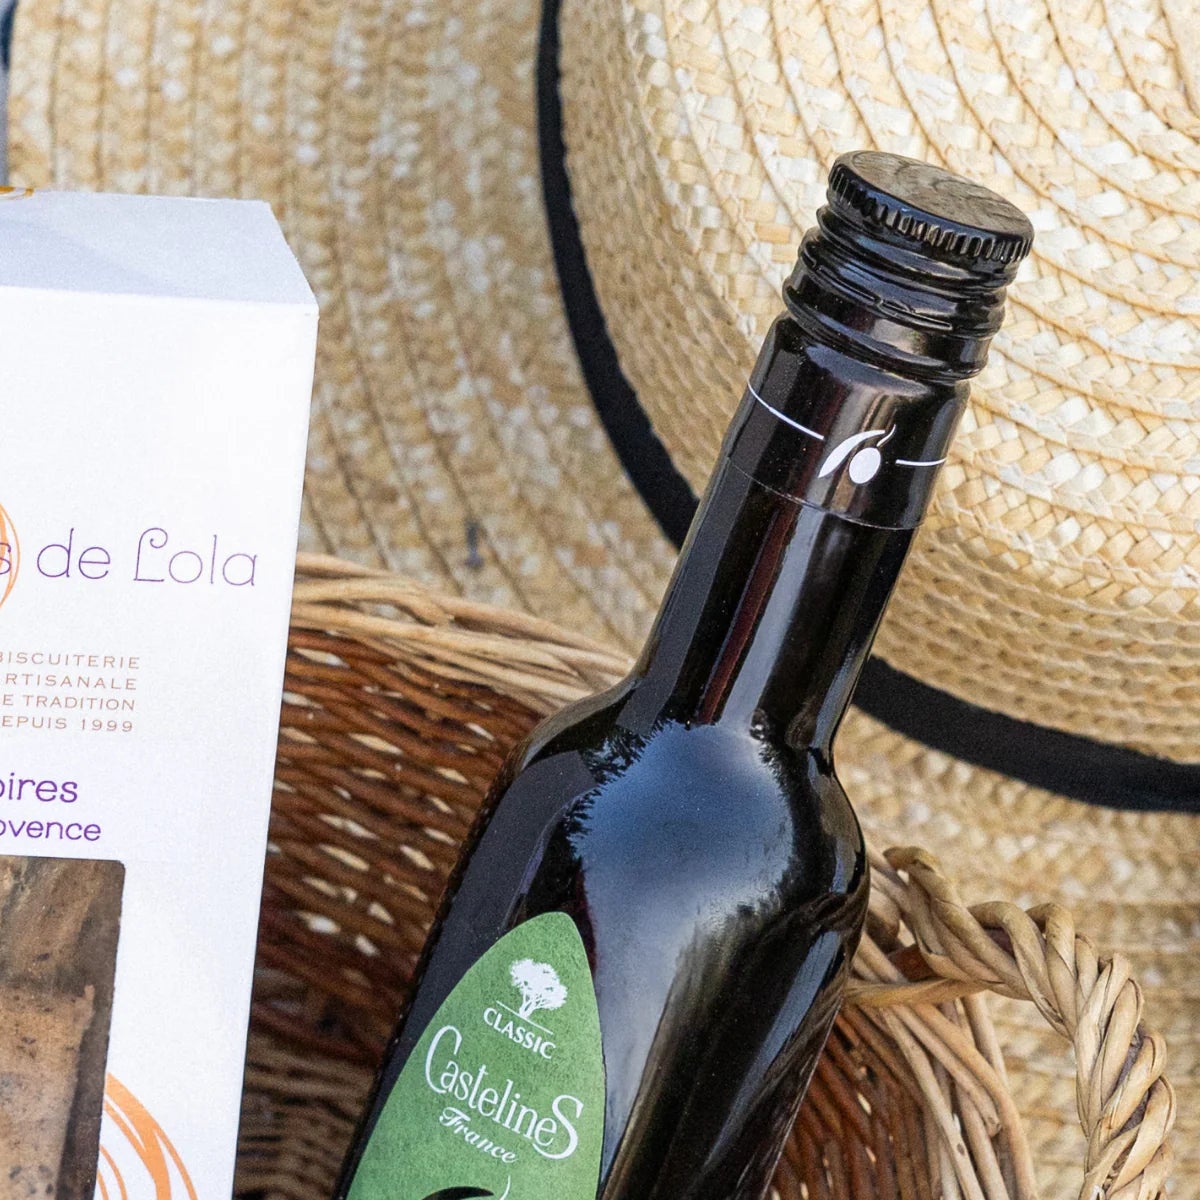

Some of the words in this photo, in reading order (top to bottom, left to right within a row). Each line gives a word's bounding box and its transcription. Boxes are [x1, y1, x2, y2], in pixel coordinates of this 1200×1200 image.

[36, 528, 111, 581] de
[133, 528, 257, 587] Lola
[22, 694, 135, 711] TRADITION
[82, 718, 133, 732] 1999
[483, 1008, 556, 1059] CLASSIC
[439, 1107, 519, 1163] France
